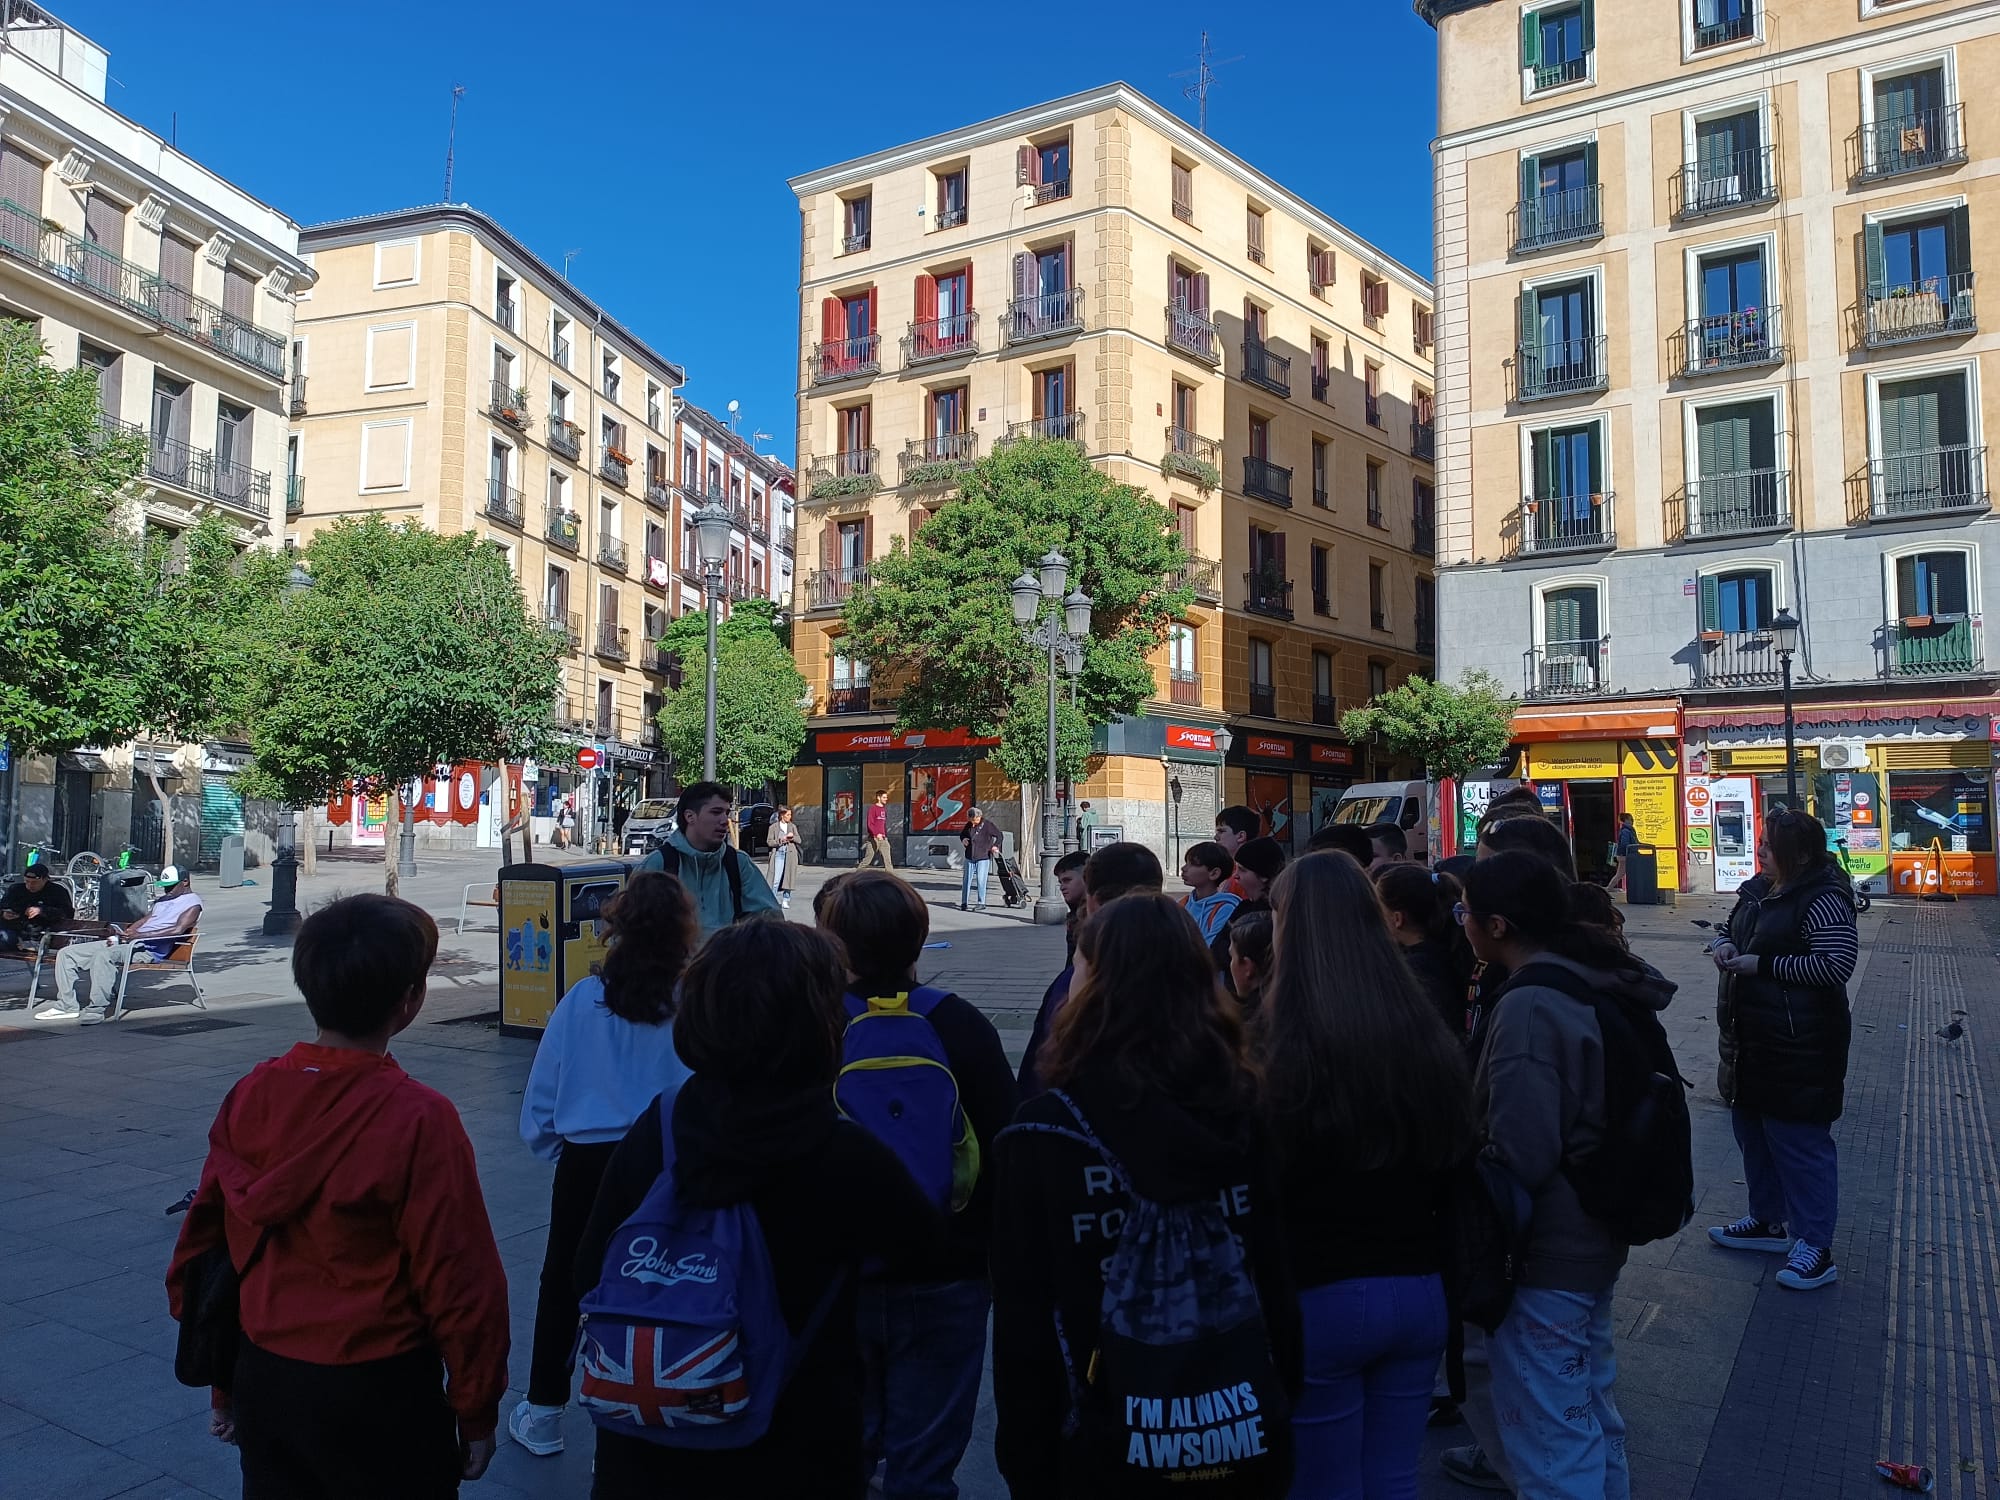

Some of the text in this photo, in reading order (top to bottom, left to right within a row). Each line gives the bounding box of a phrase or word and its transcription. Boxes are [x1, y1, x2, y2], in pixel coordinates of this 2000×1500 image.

[1709, 724, 1743, 734] MOON
[1749, 724, 1785, 733] TRAVE
[1808, 720, 1850, 729] MONEY
[1855, 717, 1920, 727] TRANSFER
[848, 735, 891, 746] SPORTIUM
[1176, 731, 1211, 743] SPORTIUM
[1256, 741, 1286, 752] SPORTIUM
[1320, 749, 1346, 759] SPORTIUM
[1551, 757, 1579, 765] Western
[1689, 788, 1708, 800] ria
[1718, 869, 1737, 877] ING
[1900, 861, 1943, 886] ria
[1072, 1206, 1128, 1245] FO
[620, 1235, 678, 1278] John
[1125, 1380, 1260, 1430] I'M ALWAYS
[1126, 1416, 1269, 1470] AWSOME
